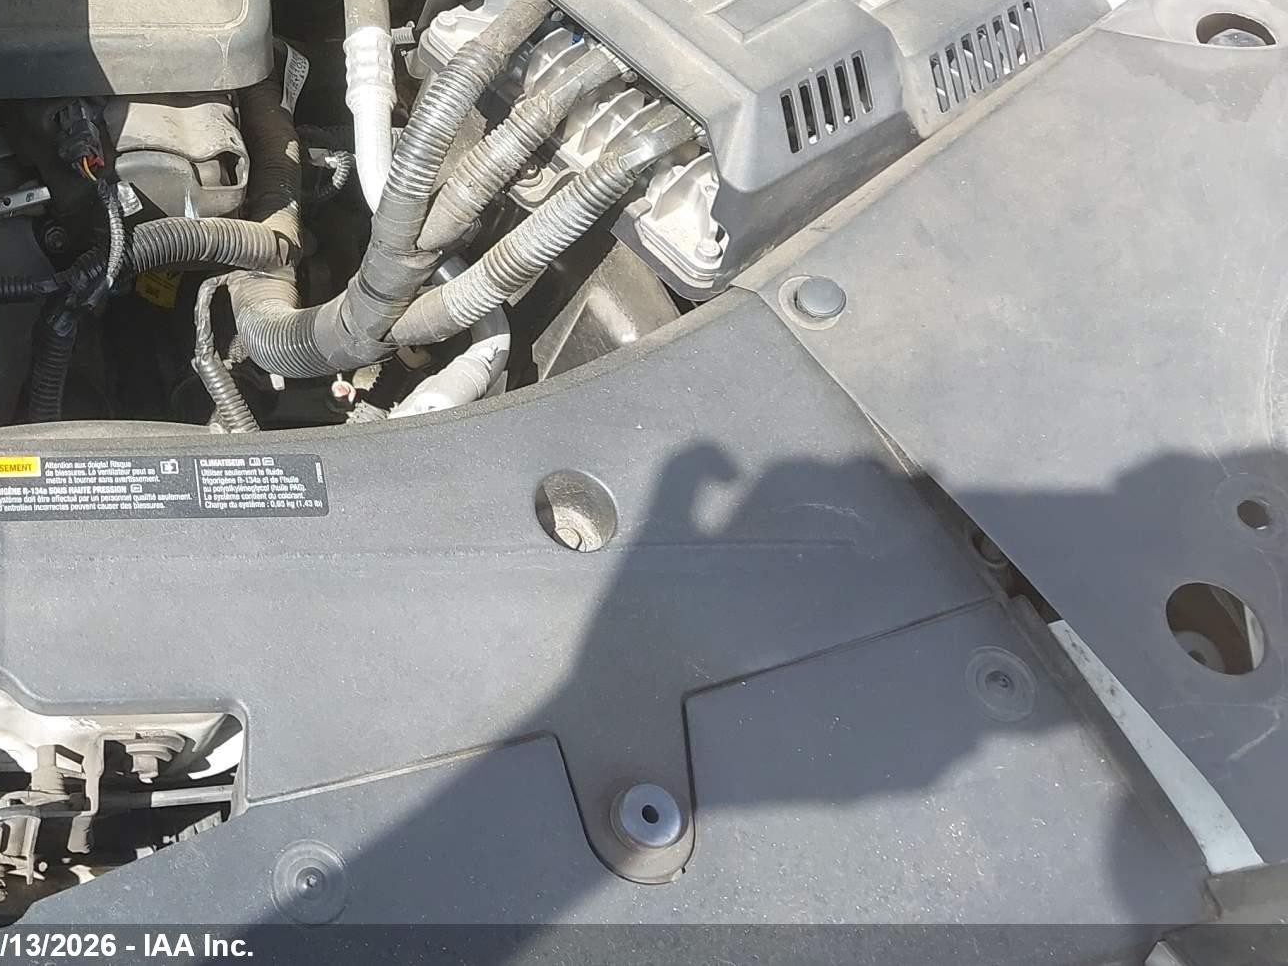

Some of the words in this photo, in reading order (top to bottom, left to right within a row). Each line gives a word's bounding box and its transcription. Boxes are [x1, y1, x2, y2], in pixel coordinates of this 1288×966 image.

[45, 461, 73, 469] Attention
[109, 460, 131, 468] Risque
[200, 458, 246, 467] CLIMATISEUR
[131, 468, 146, 476] peut
[224, 468, 257, 476] seulement
[237, 476, 261, 484] R-134a
[22, 487, 47, 495] R-134a
[48, 486, 67, 494] SOUS
[68, 486, 92, 494] HAUTE
[92, 485, 127, 494] PRESSION
[23, 495, 36, 503] doit
[78, 495, 90, 503] par
[100, 494, 132, 503] personnel
[33, 503, 69, 511] incorrectes
[70, 503, 96, 511] peuvent
[120, 502, 132, 510] des
[205, 501, 228, 509] Charge
[228, 500, 238, 508] du
[286, 500, 295, 509] kg
